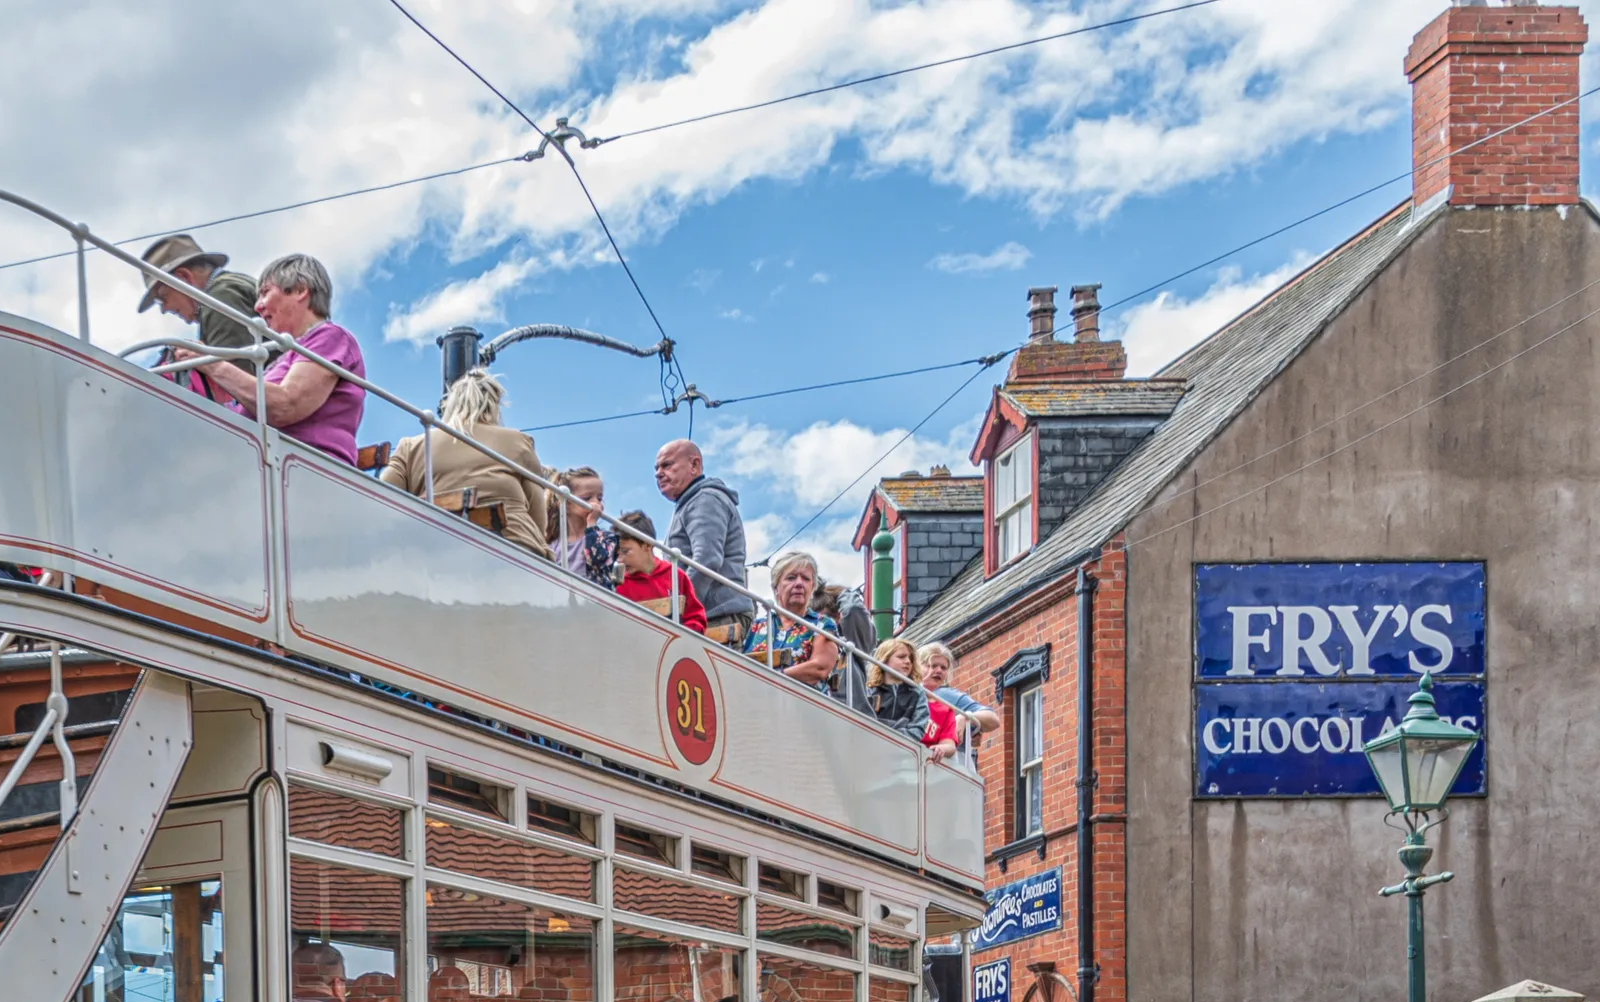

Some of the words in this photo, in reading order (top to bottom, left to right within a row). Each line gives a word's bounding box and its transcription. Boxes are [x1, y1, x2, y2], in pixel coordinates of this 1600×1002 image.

[1226, 604, 1454, 676] FRY'S
[677, 679, 707, 741] 31
[1021, 878, 1057, 903] CHOCOLATES
[1022, 906, 1057, 929] PASTILLES
